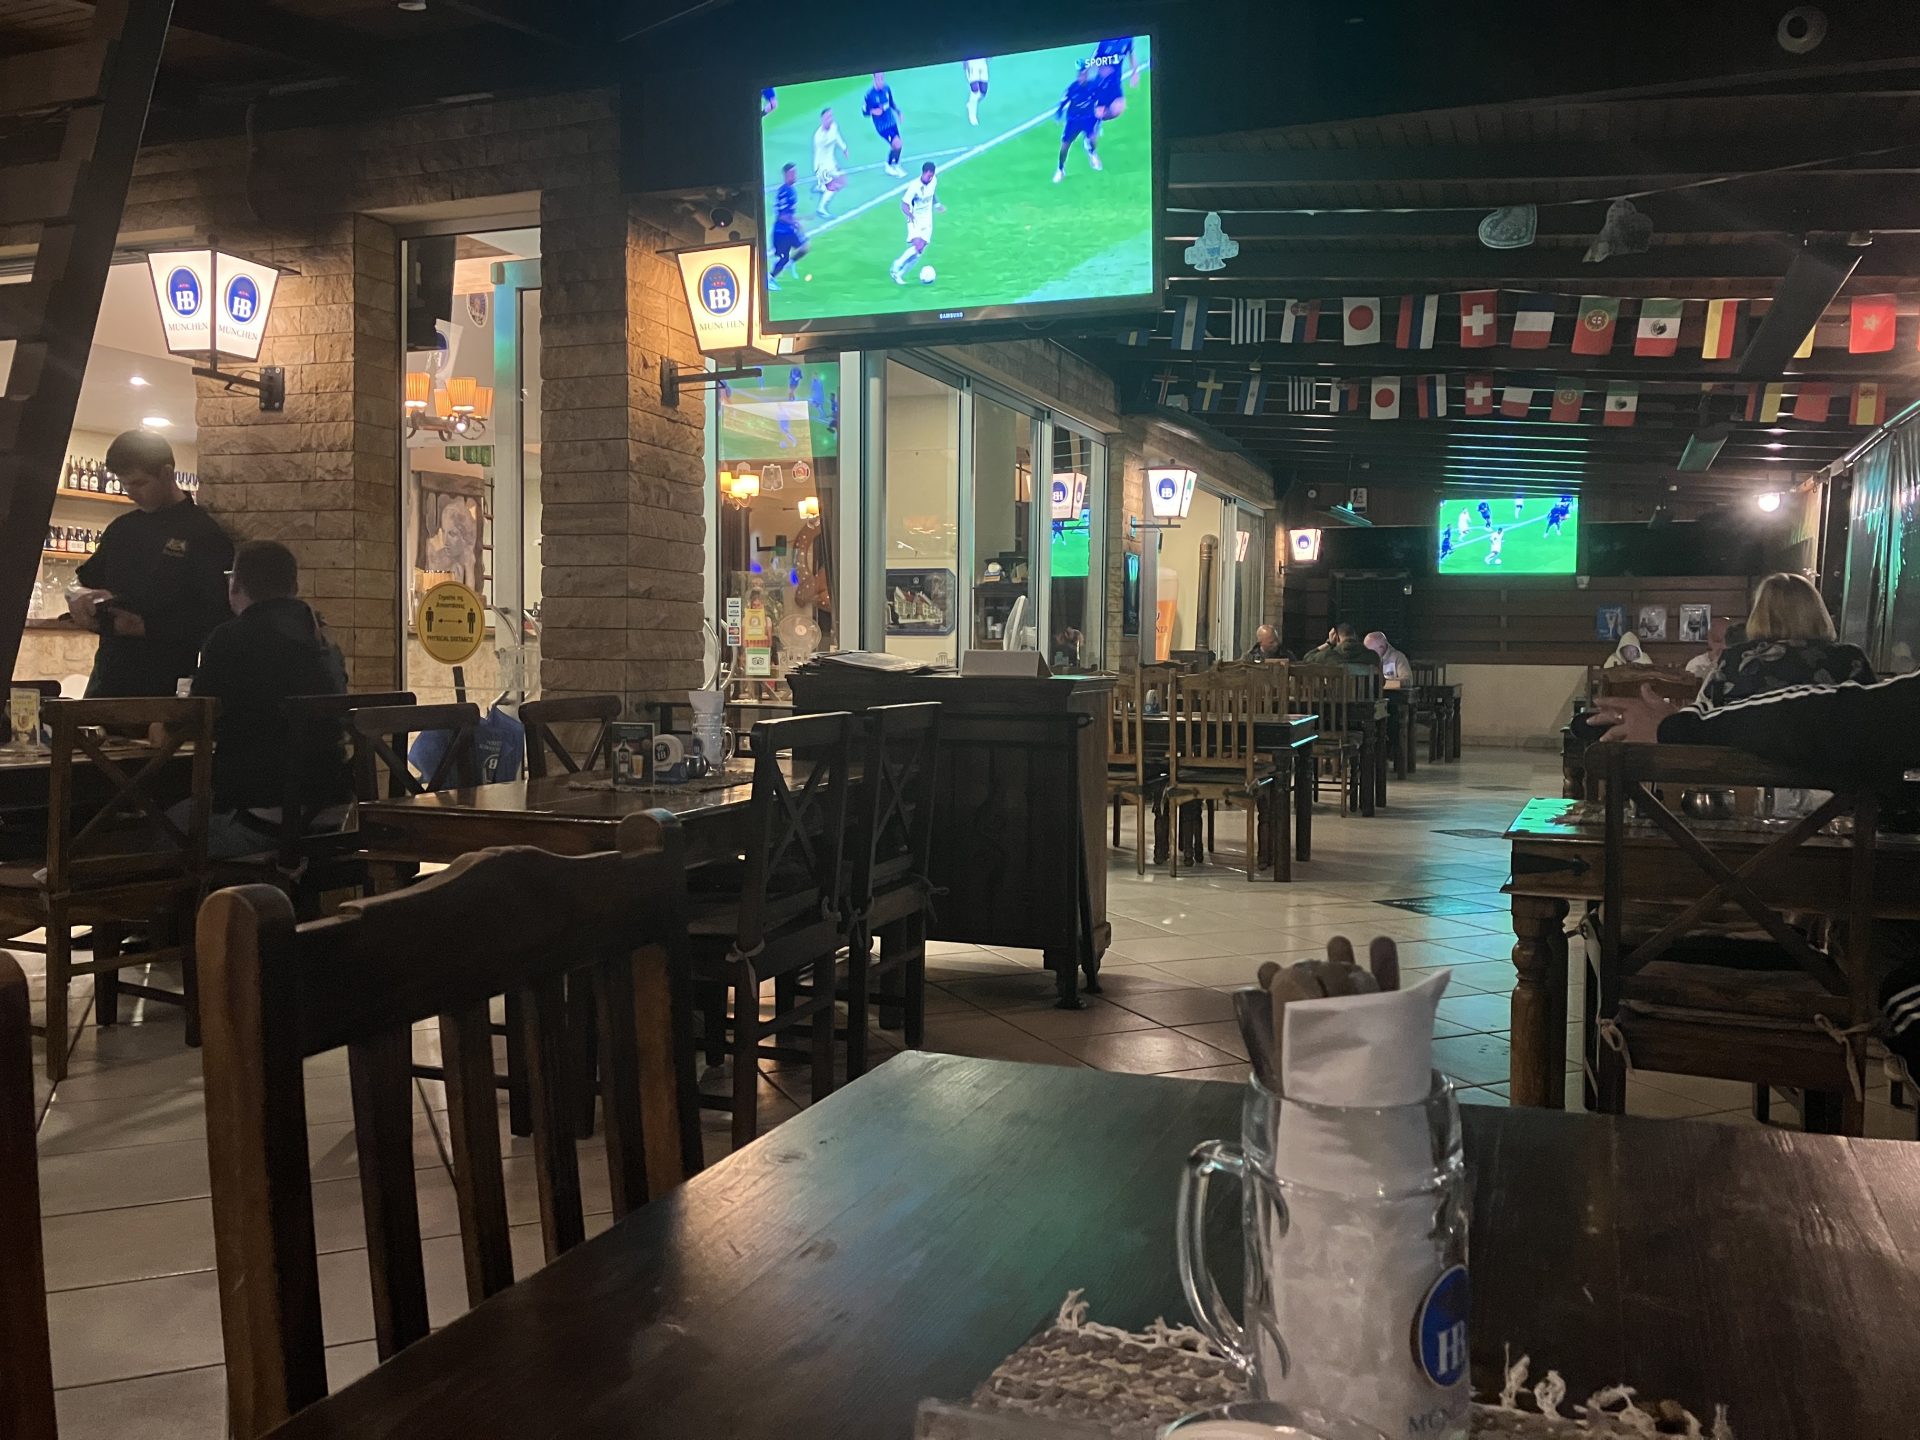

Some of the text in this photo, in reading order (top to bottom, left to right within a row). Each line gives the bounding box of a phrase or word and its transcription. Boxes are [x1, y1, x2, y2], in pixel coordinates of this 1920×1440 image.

[1085, 54, 1119, 68] SPORT1
[175, 290, 196, 311] HB
[232, 296, 252, 318] HB
[708, 288, 731, 309] HB
